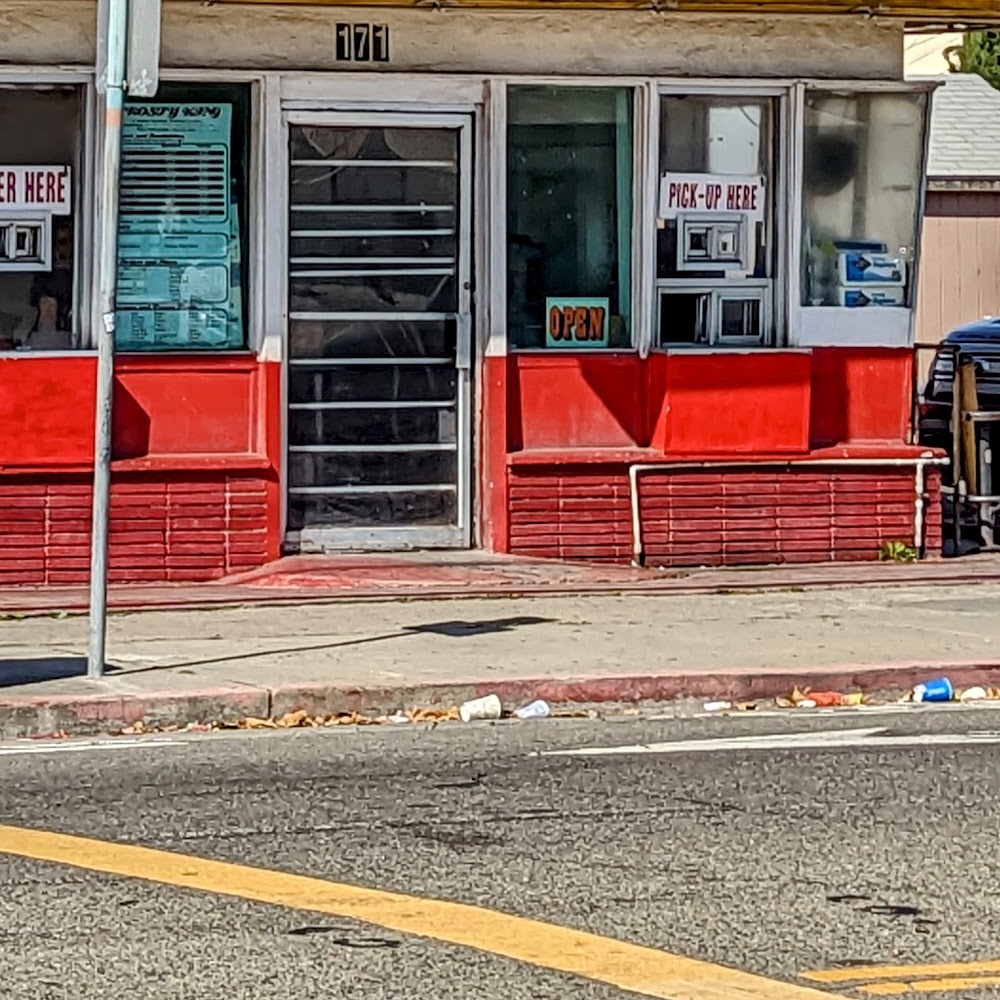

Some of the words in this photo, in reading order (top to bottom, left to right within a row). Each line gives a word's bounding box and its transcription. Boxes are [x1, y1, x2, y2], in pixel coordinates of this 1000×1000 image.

[336, 23, 389, 61] 171
[24, 170, 67, 203] HERE
[668, 183, 722, 210] PICK-UP
[726, 184, 758, 210] HERE
[549, 305, 605, 341] OPEN
